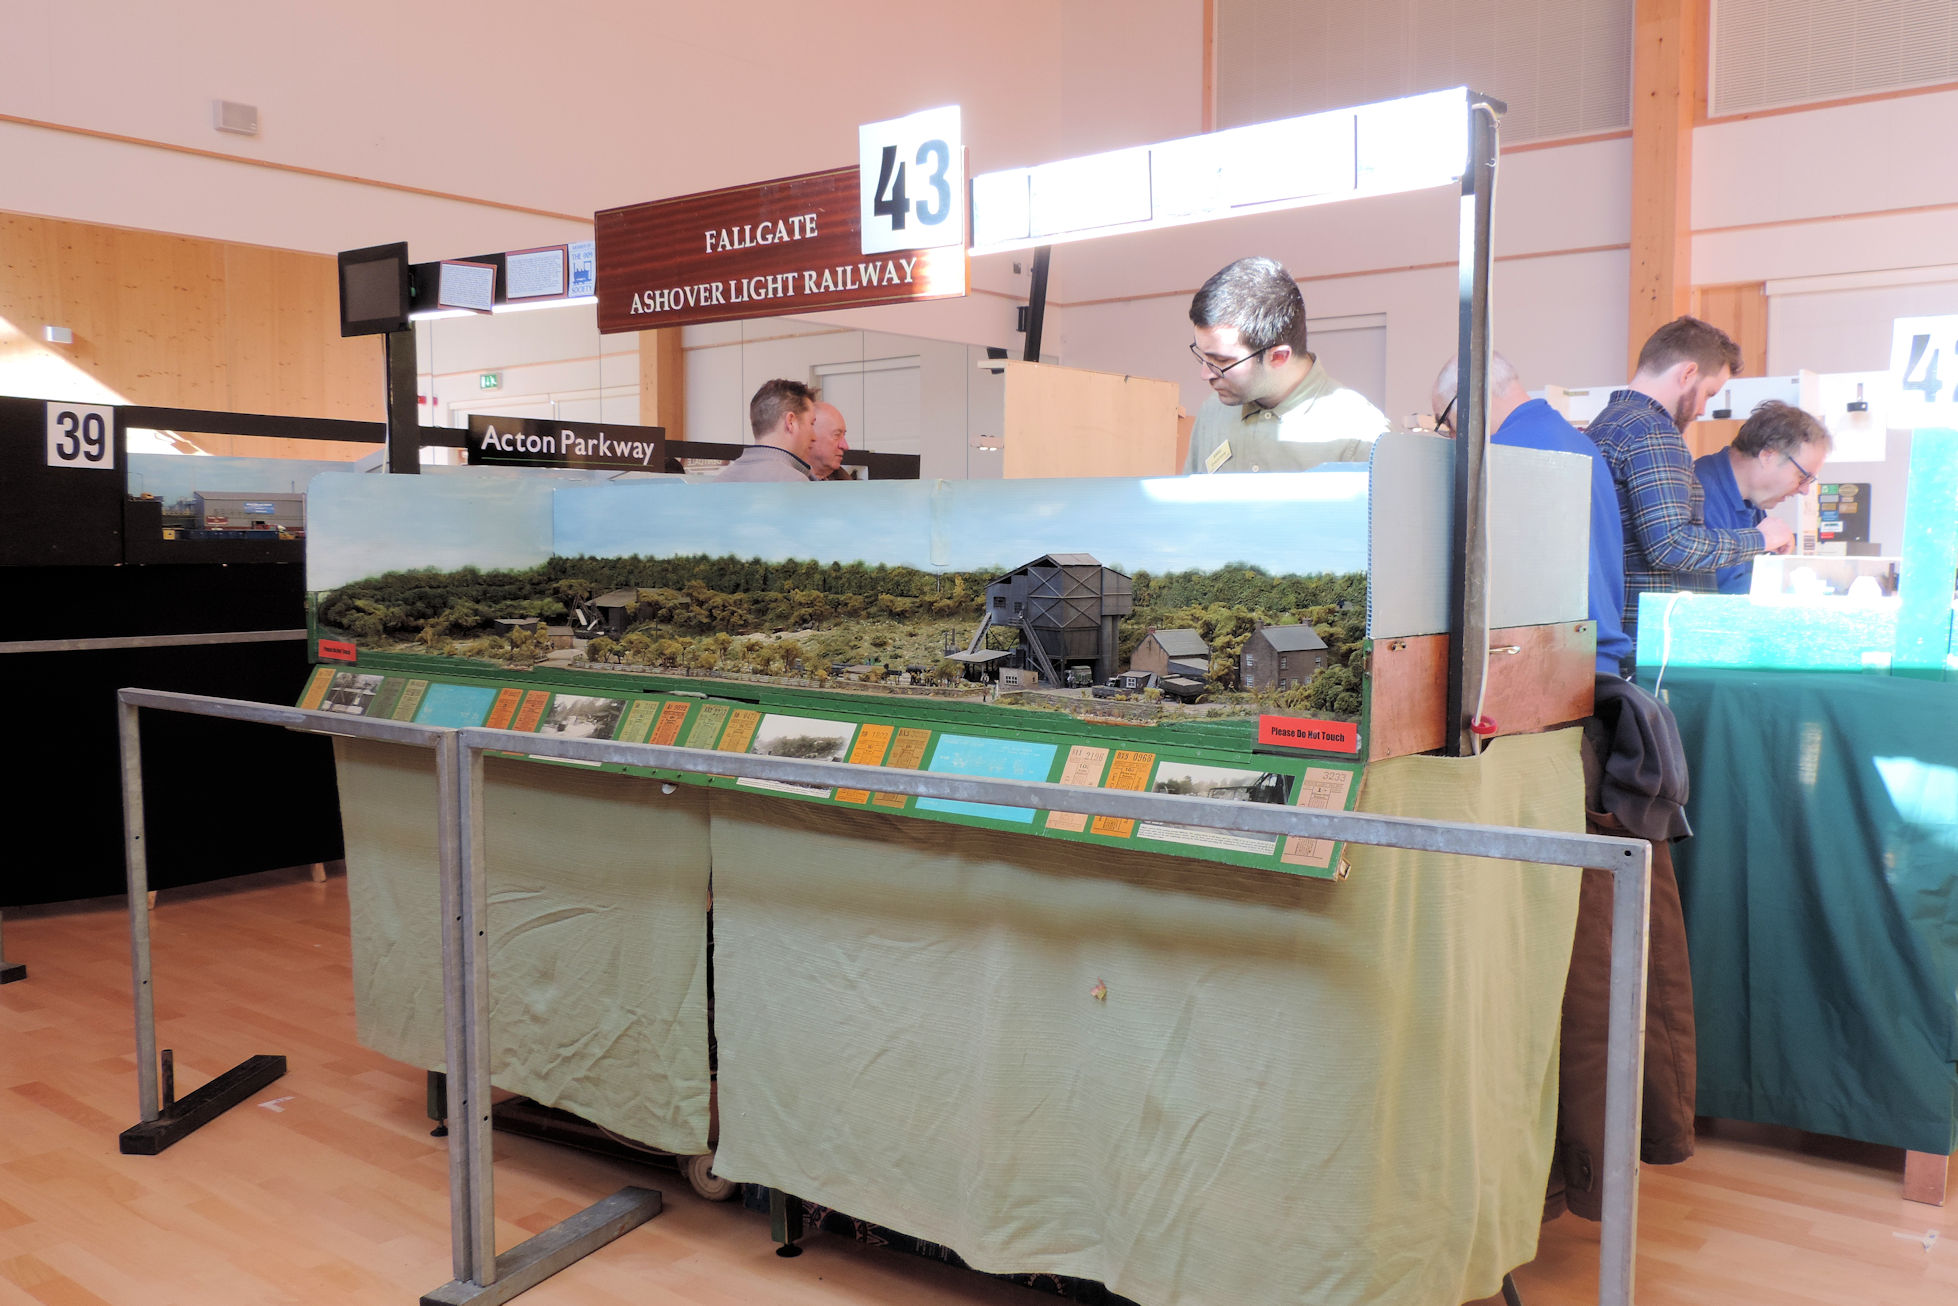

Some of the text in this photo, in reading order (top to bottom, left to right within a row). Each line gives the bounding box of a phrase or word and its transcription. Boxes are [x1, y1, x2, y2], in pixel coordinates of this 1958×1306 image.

[873, 138, 951, 232] 43
[704, 213, 819, 255] FALLGATE
[629, 257, 918, 316] ASHOVER LIGHT RAILWAY
[1902, 333, 1958, 403] 4
[55, 410, 106, 463] 39
[481, 424, 655, 466] Acton Parkway
[1271, 726, 1345, 743] Please Do Not Touch
